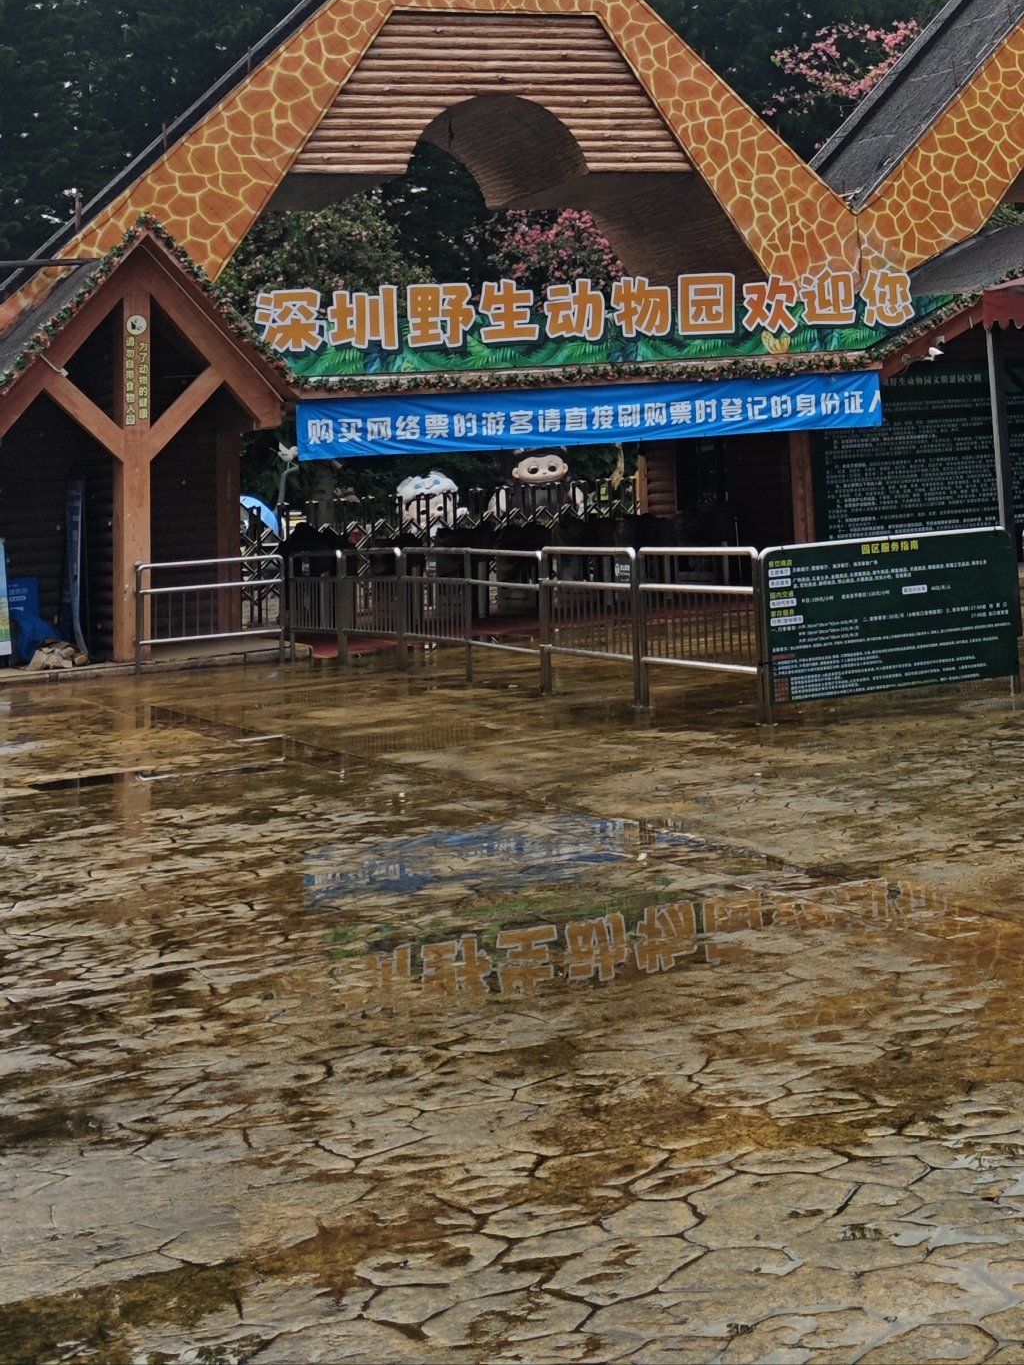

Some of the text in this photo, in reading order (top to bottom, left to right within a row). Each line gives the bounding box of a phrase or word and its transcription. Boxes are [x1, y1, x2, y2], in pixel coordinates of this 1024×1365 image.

[254, 268, 915, 352] 深圳野生动物园欢迎您
[861, 539, 920, 555] 园区服务指南
